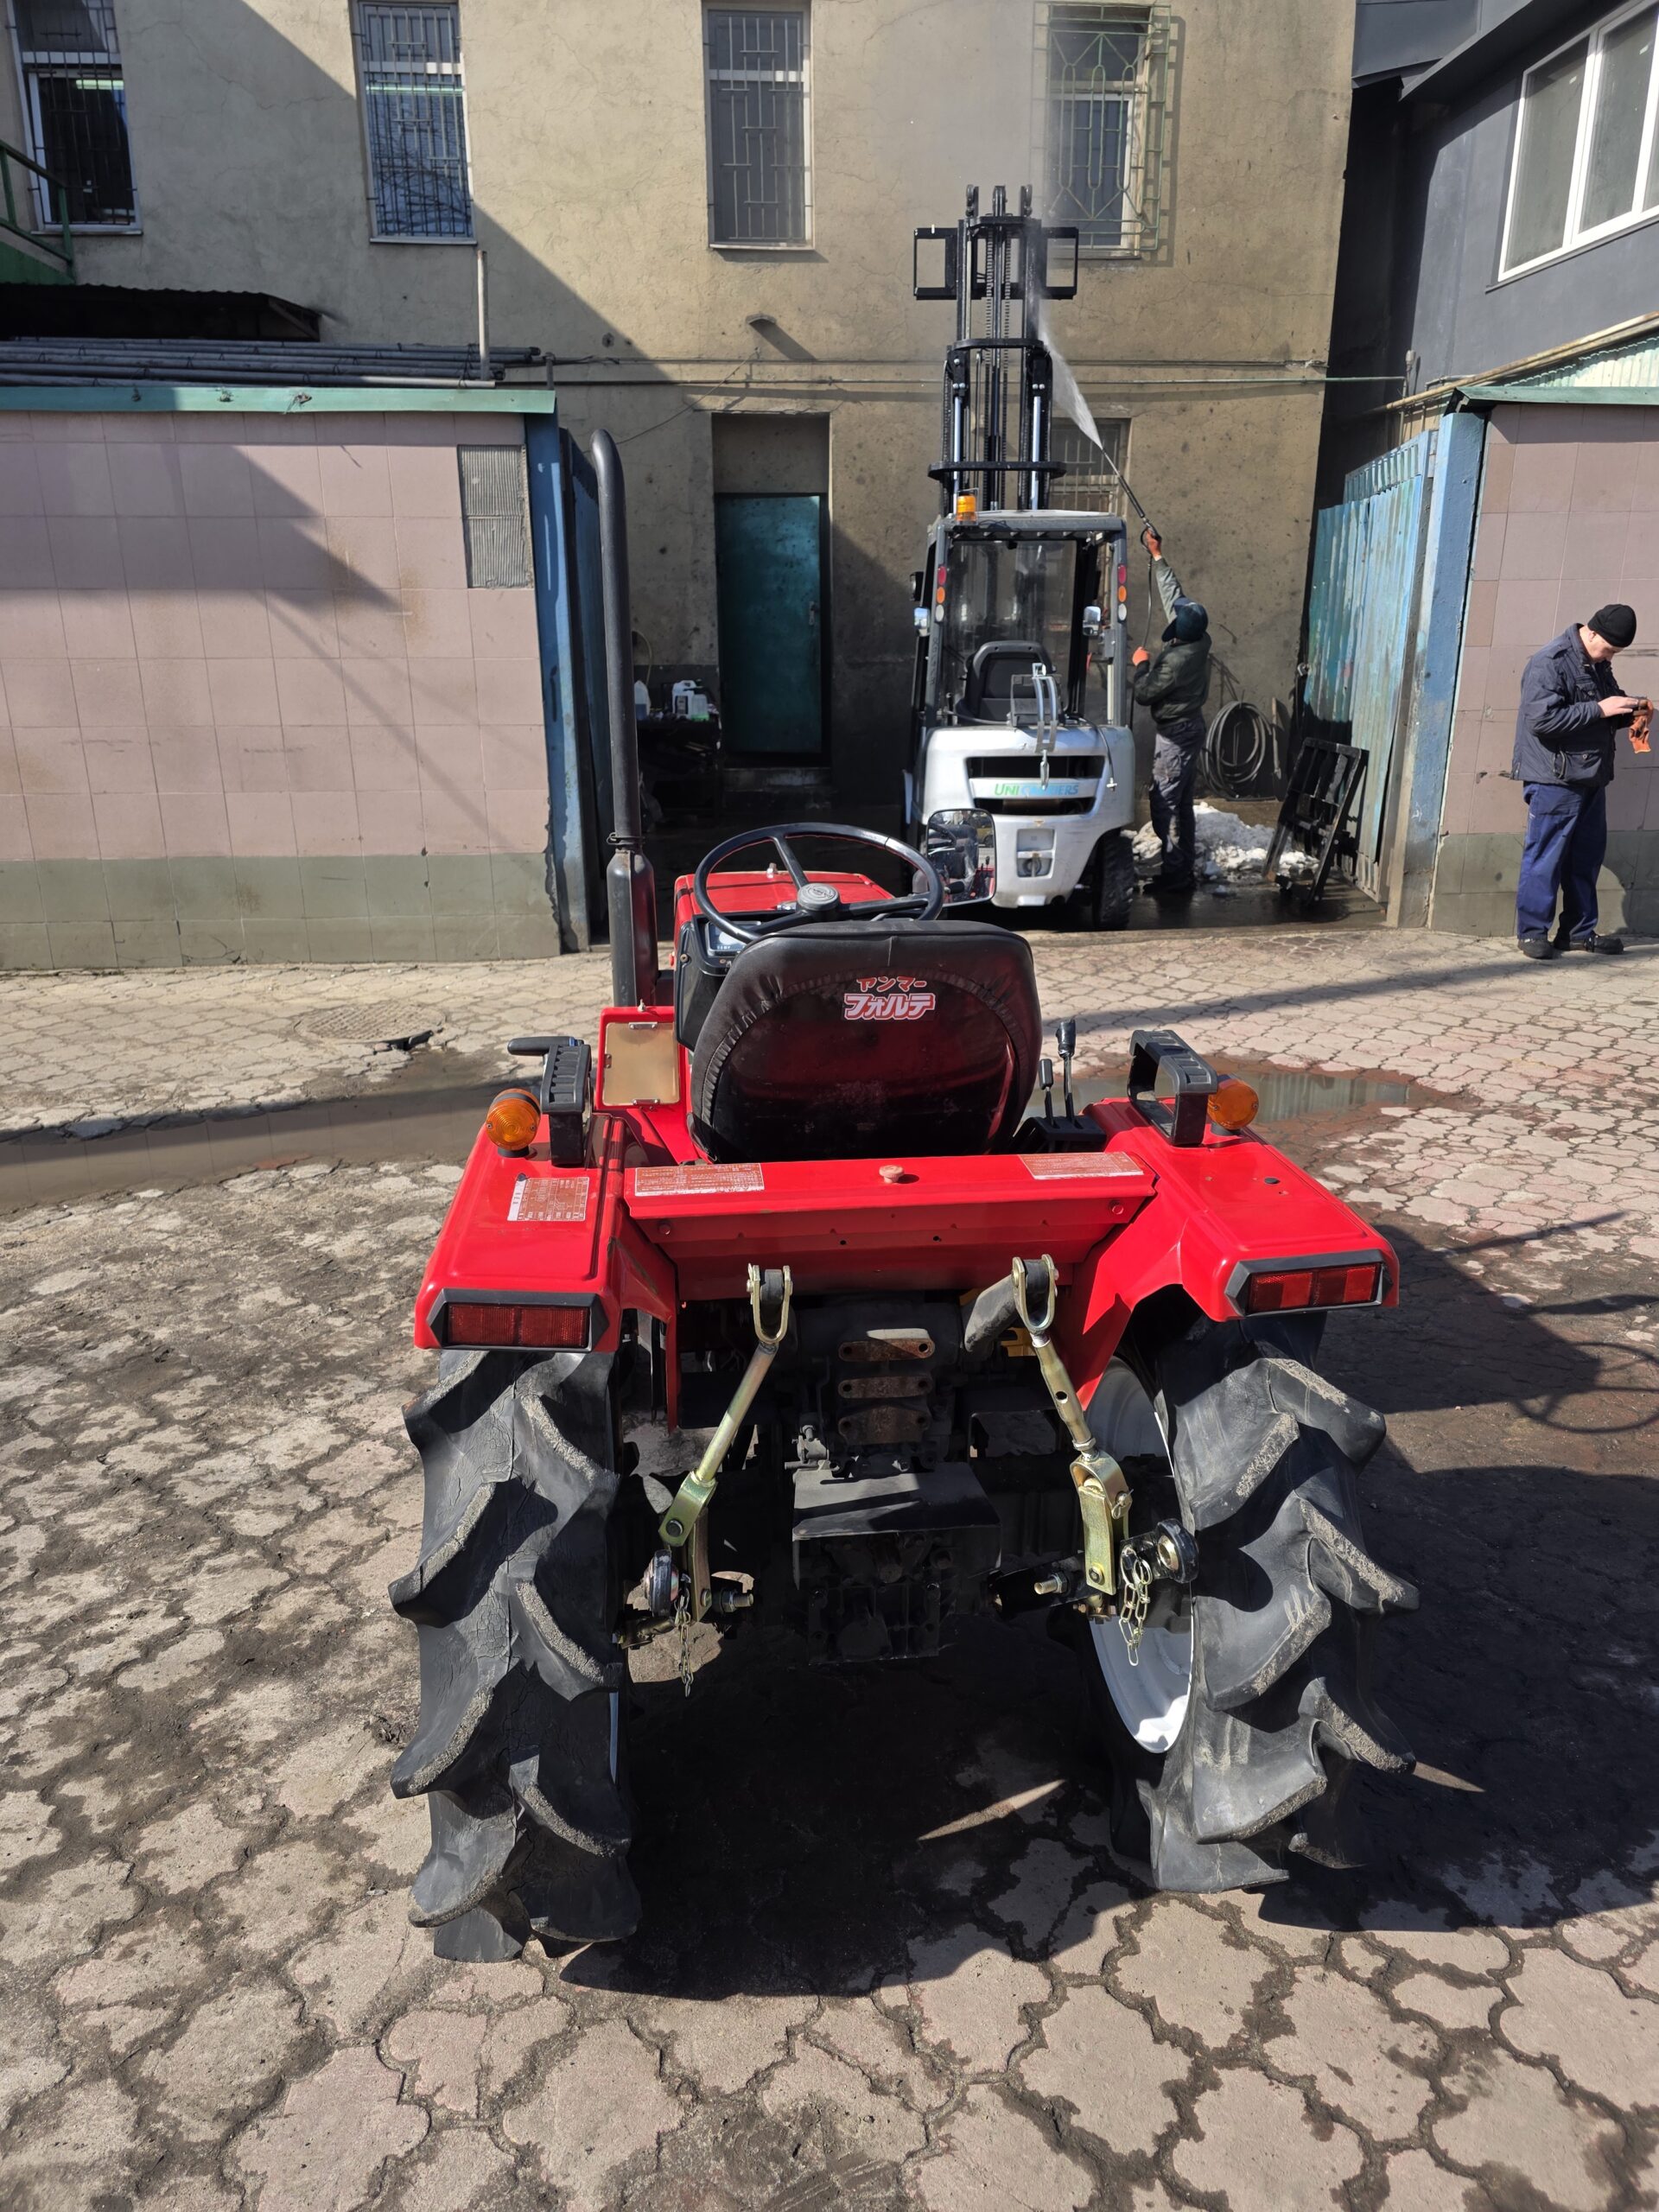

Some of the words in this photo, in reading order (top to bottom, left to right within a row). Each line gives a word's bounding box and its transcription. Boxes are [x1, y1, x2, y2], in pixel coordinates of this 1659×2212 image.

[994, 783, 1079, 796] UNICRIERS
[856, 976, 927, 992] ヤンマー
[844, 993, 936, 1020] フォルテ
